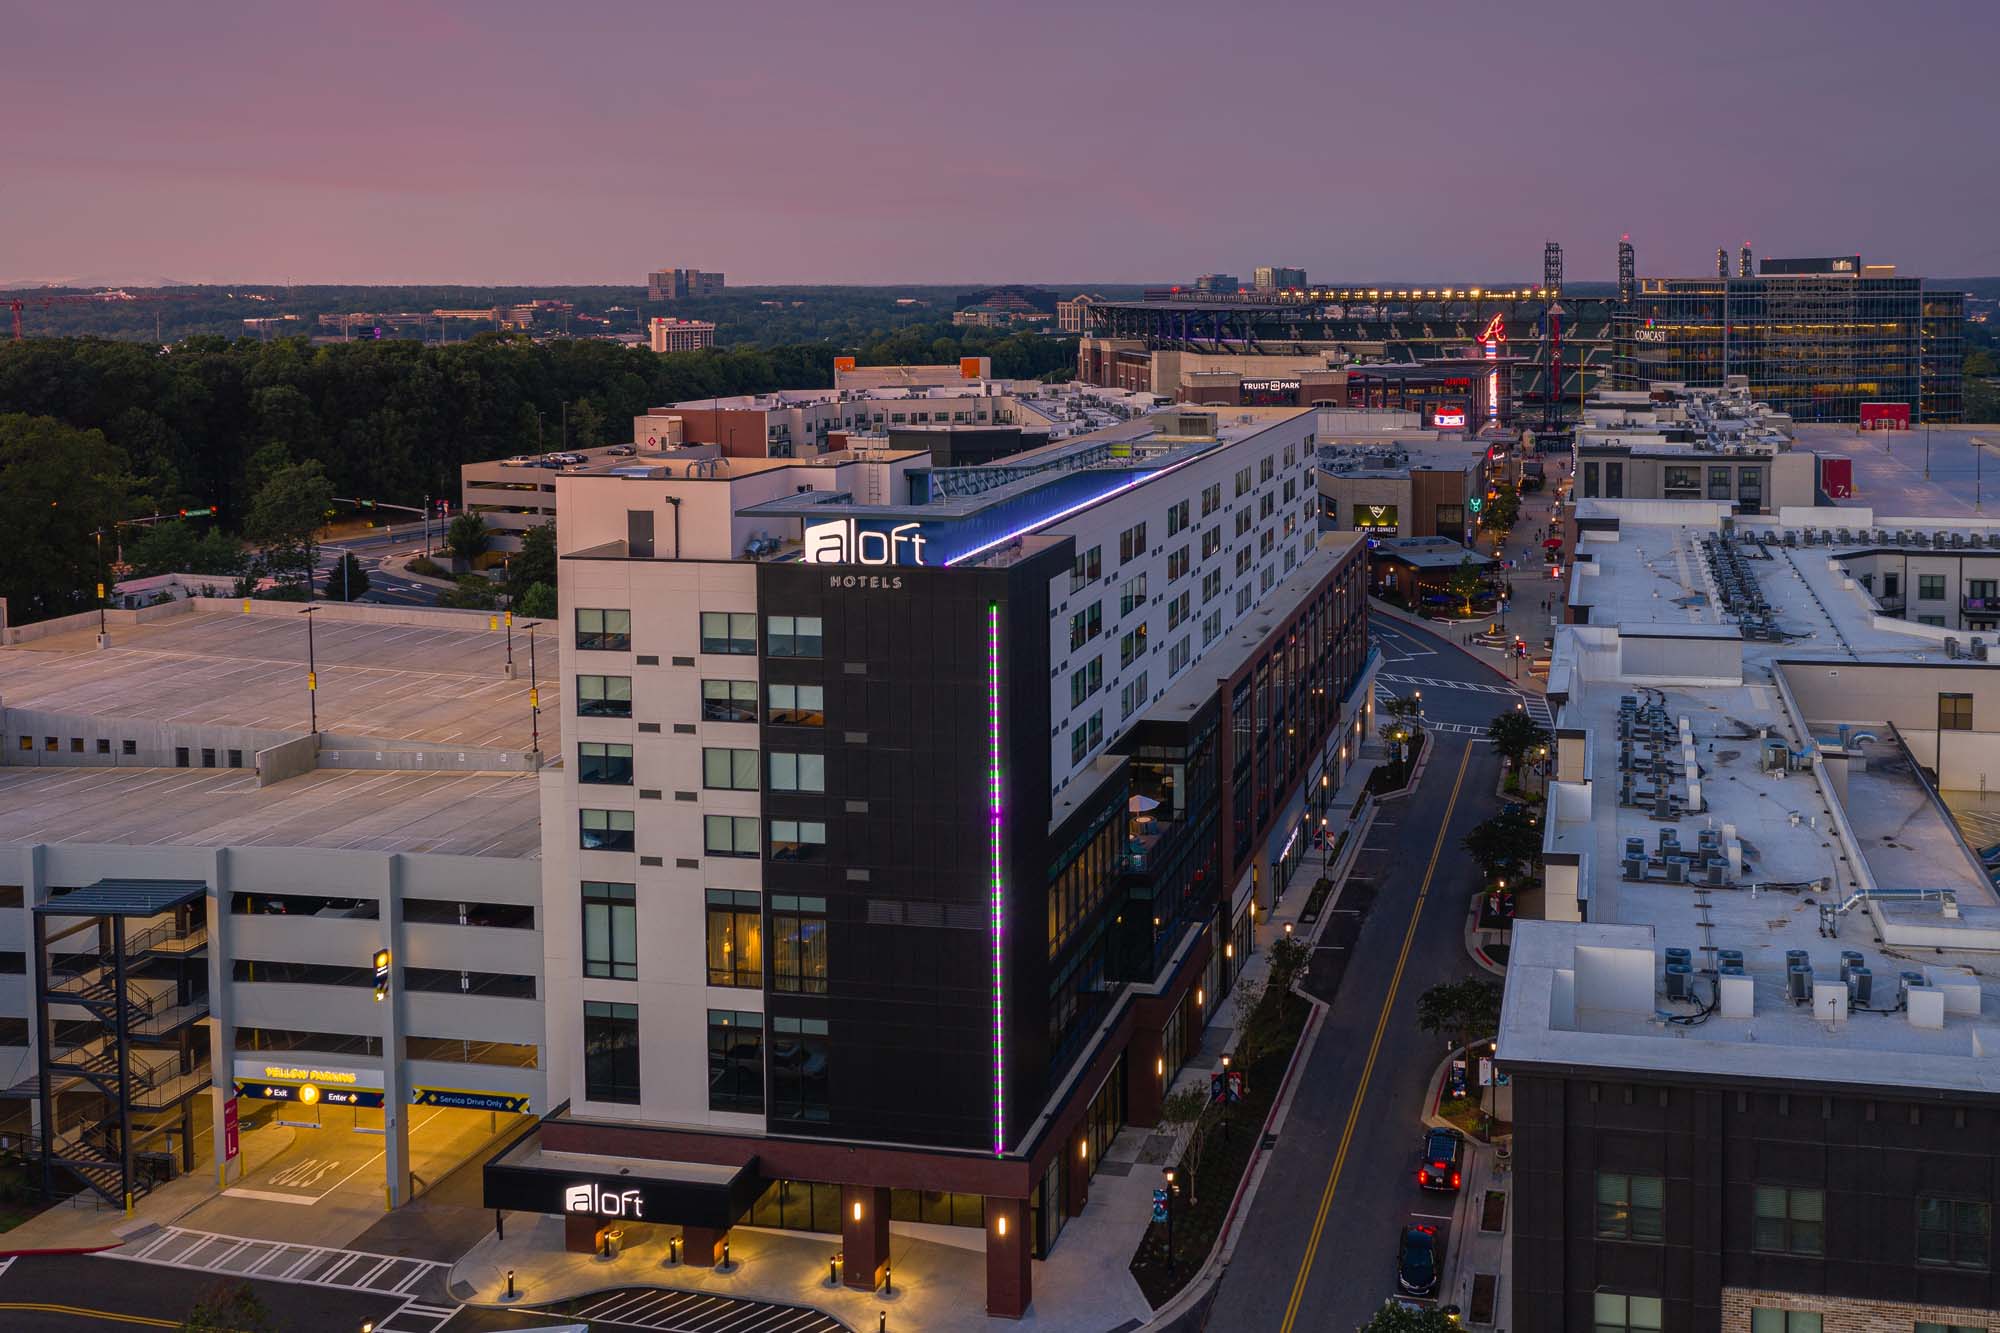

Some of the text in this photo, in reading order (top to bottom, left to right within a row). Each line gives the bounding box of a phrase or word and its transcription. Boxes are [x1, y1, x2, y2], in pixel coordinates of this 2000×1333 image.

[1635, 330, 1665, 341] COMCAST
[805, 518, 926, 566] aloft
[830, 576, 902, 589] HOTELS
[264, 1066, 356, 1084] YELLOW PARKING
[274, 1089, 287, 1097] Exit
[304, 1087, 315, 1102] P
[328, 1093, 347, 1102] Enter
[440, 1095, 503, 1108] Service Drive Only
[268, 1158, 340, 1188] STOP
[565, 1183, 643, 1217] aloft
